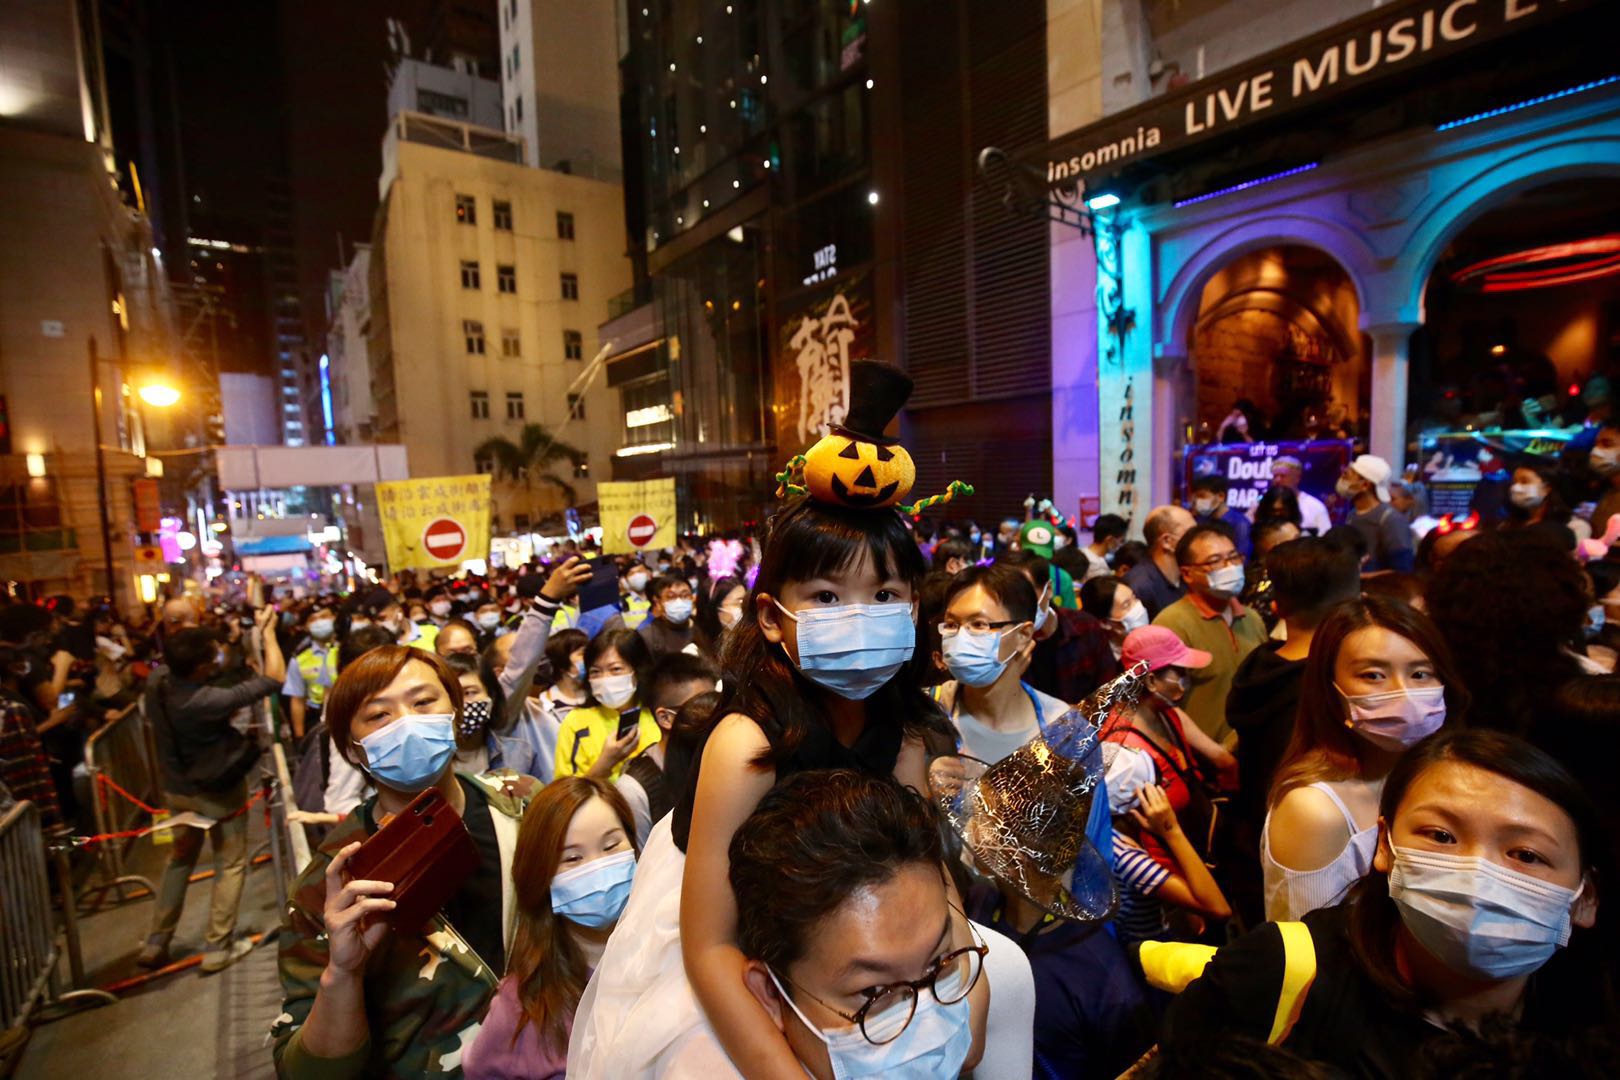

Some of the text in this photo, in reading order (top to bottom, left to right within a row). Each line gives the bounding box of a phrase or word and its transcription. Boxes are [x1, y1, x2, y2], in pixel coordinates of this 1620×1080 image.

[1047, 0, 1477, 183] insomnia LIVE MUSIC
[1117, 376, 1136, 516] insomn
